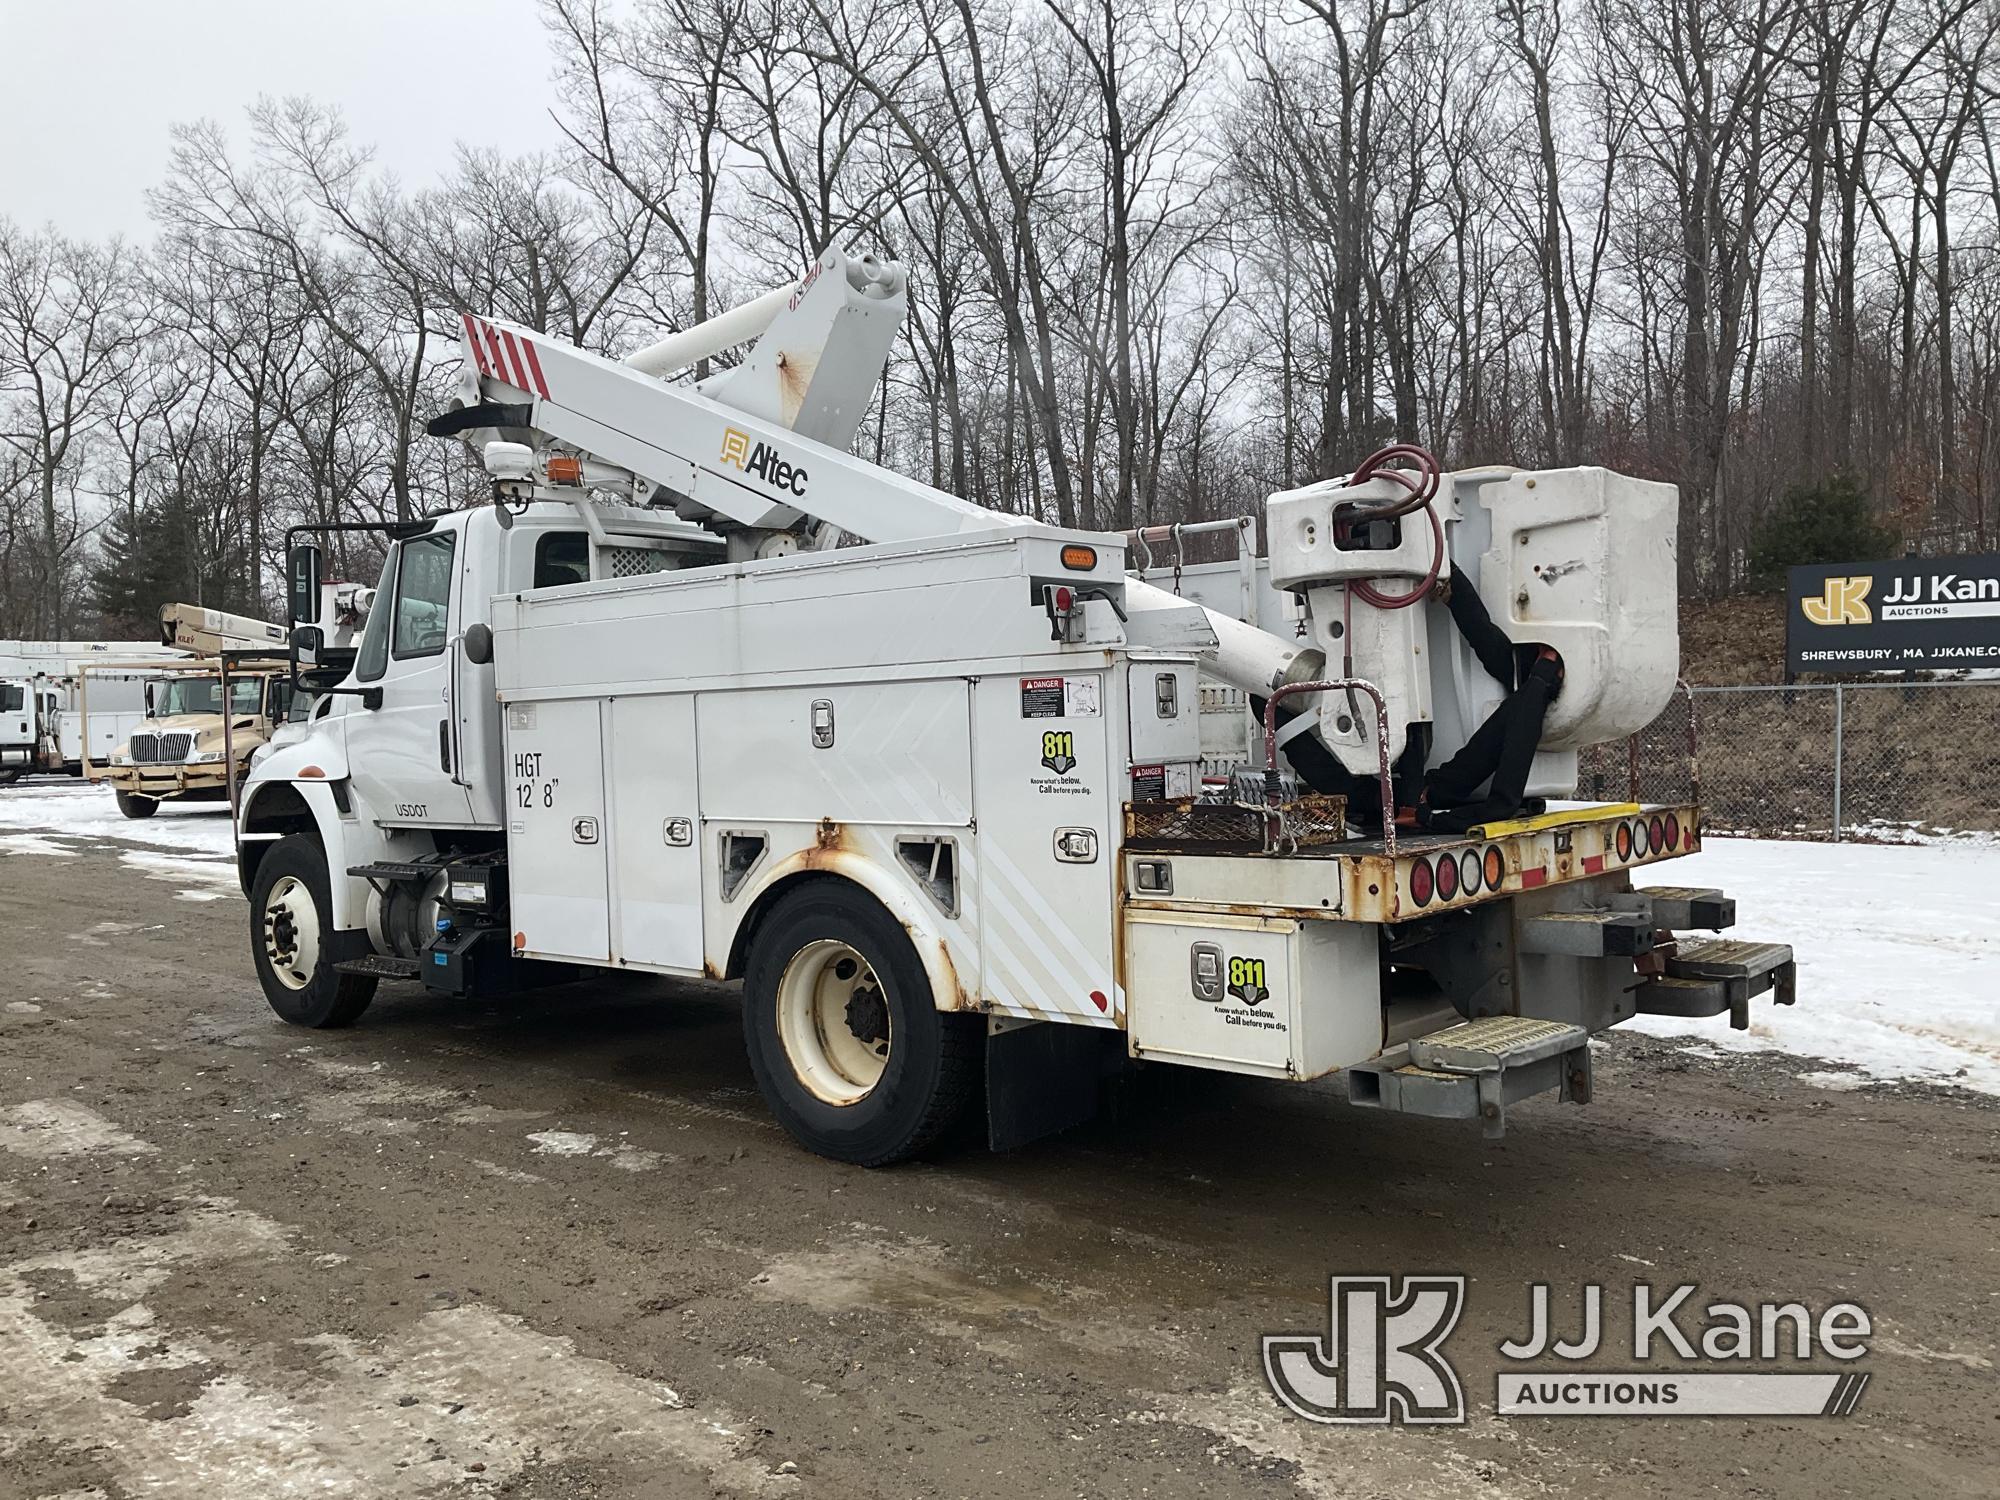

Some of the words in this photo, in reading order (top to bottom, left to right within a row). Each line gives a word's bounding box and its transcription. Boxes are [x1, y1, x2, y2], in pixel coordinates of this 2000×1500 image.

[745, 442, 808, 496] Altec
[1882, 576, 1922, 603] JJ
[1889, 606, 1949, 617] AUCTIONS
[1801, 649, 1892, 661] SHREWSBURY
[1903, 648, 1924, 658] MA
[1931, 646, 2000, 658] JJKANE.C
[1033, 680, 1059, 688] DANGER
[1042, 731, 1072, 758] 811
[515, 753, 542, 777] HGT
[1141, 767, 1162, 776] DANGER
[1061, 776, 1081, 785] below.
[1039, 785, 1052, 794] Call
[1081, 787, 1092, 795] dig.
[395, 804, 428, 817] USDOT
[1229, 957, 1265, 988] 811
[1214, 1006, 1230, 1014] Know
[1231, 1008, 1249, 1016] what's
[1249, 1008, 1275, 1019] below.
[1225, 1015, 1241, 1025] Call
[1242, 1018, 1263, 1028] before
[1263, 1021, 1275, 1030] you
[1275, 1022, 1288, 1032] dig.
